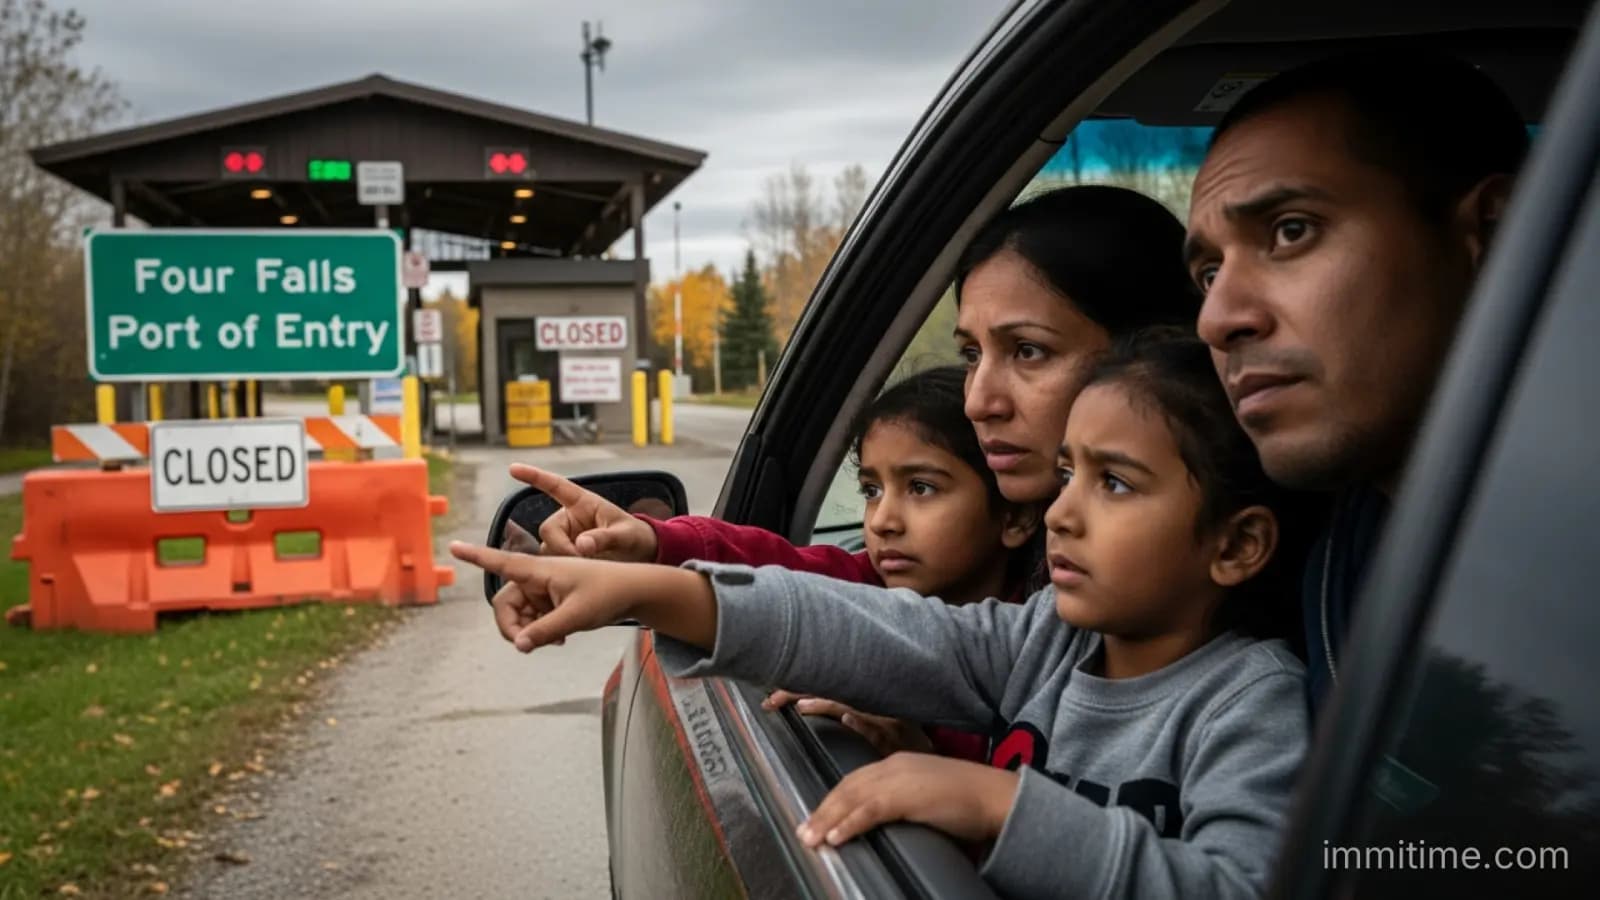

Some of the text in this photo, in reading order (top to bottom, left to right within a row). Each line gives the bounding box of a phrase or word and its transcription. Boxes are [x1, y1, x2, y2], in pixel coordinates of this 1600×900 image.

[134, 258, 356, 294] Four Falls
[108, 314, 201, 350] Port
[218, 313, 260, 349] of
[276, 313, 389, 356] Entry
[540, 322, 623, 345] CLOSED
[163, 445, 296, 486] CLOSED
